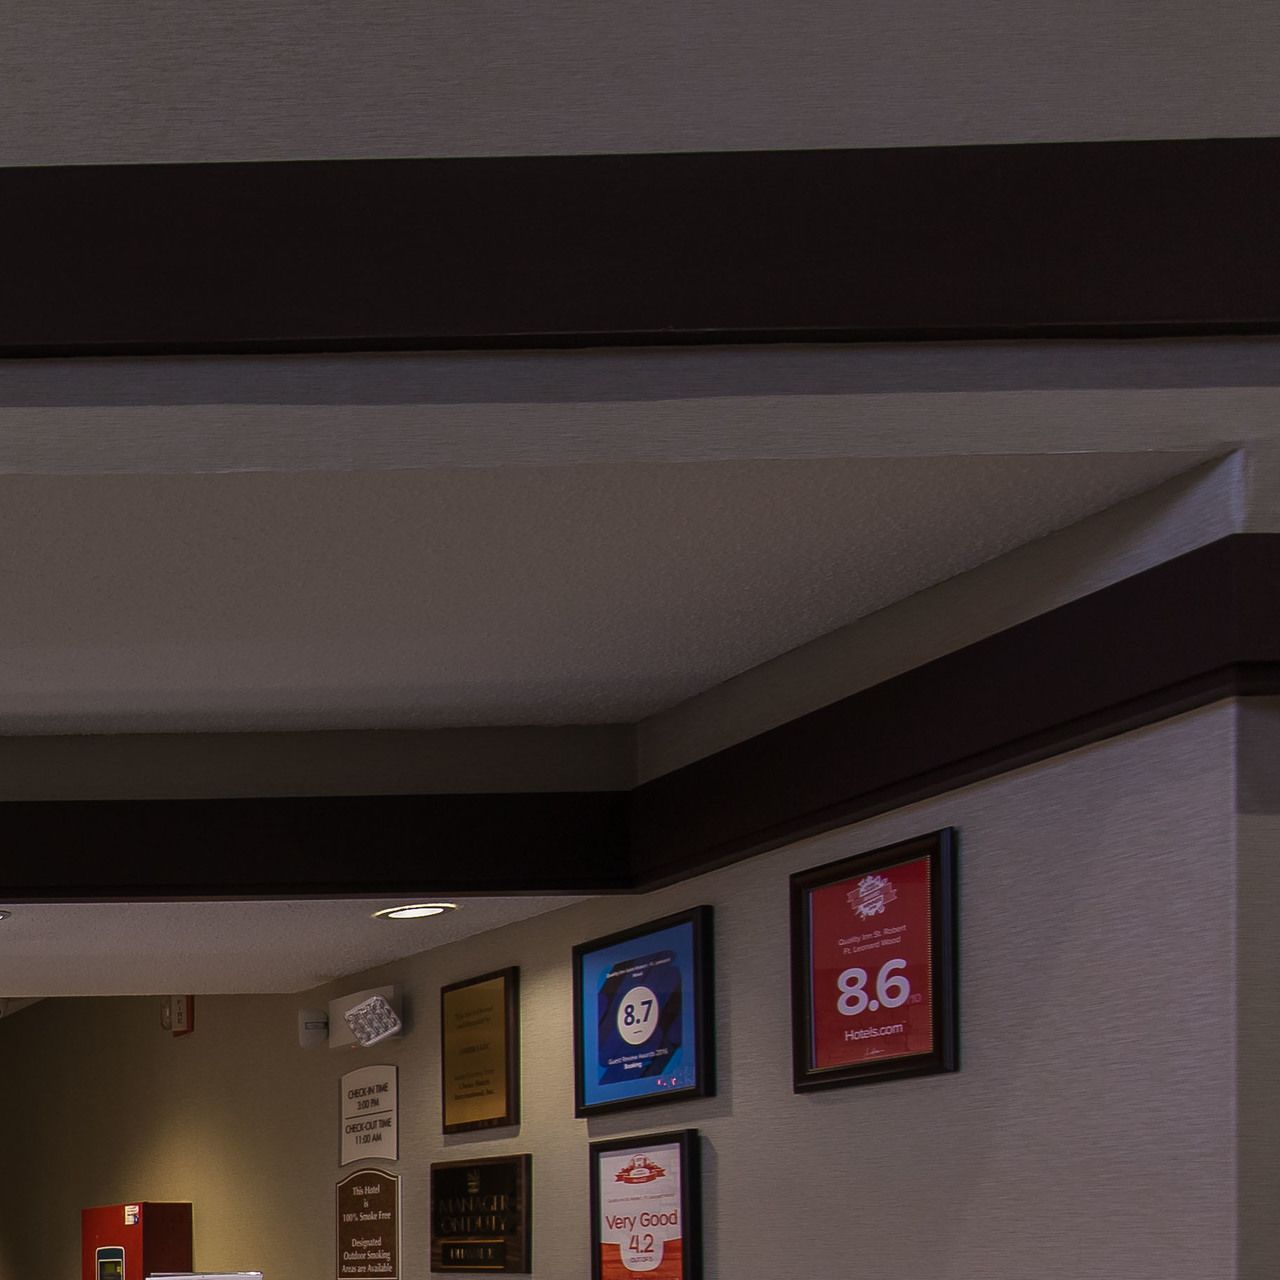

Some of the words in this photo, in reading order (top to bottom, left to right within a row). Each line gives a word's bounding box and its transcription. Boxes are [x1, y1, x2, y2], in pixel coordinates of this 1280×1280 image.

[837, 958, 910, 1016] 8.6
[624, 999, 654, 1026] 8.7
[845, 1024, 903, 1041] Hotels.com
[347, 1086, 375, 1099] CHECK-IN
[375, 1082, 389, 1092] TIME
[357, 1100, 369, 1110] 3:00
[371, 1098, 379, 1107] PM
[345, 1120, 377, 1134] CHECK-OUT
[378, 1118, 392, 1128] TIME
[355, 1134, 371, 1144] 11:00
[372, 1132, 382, 1143] AM
[352, 1186, 363, 1195] This
[364, 1184, 380, 1194] Hotel
[343, 1213, 358, 1222] 100%
[360, 1211, 377, 1221] Smoke
[378, 1211, 391, 1220] Free
[605, 1215, 636, 1232] Very
[640, 1209, 677, 1227] Good
[352, 1236, 382, 1249] Designated
[629, 1234, 654, 1253] 4.2
[343, 1251, 366, 1260] Outdoor
[367, 1250, 391, 1261] Smoking
[342, 1265, 356, 1273] Areas
[357, 1265, 366, 1273] are
[368, 1263, 392, 1273] Available
